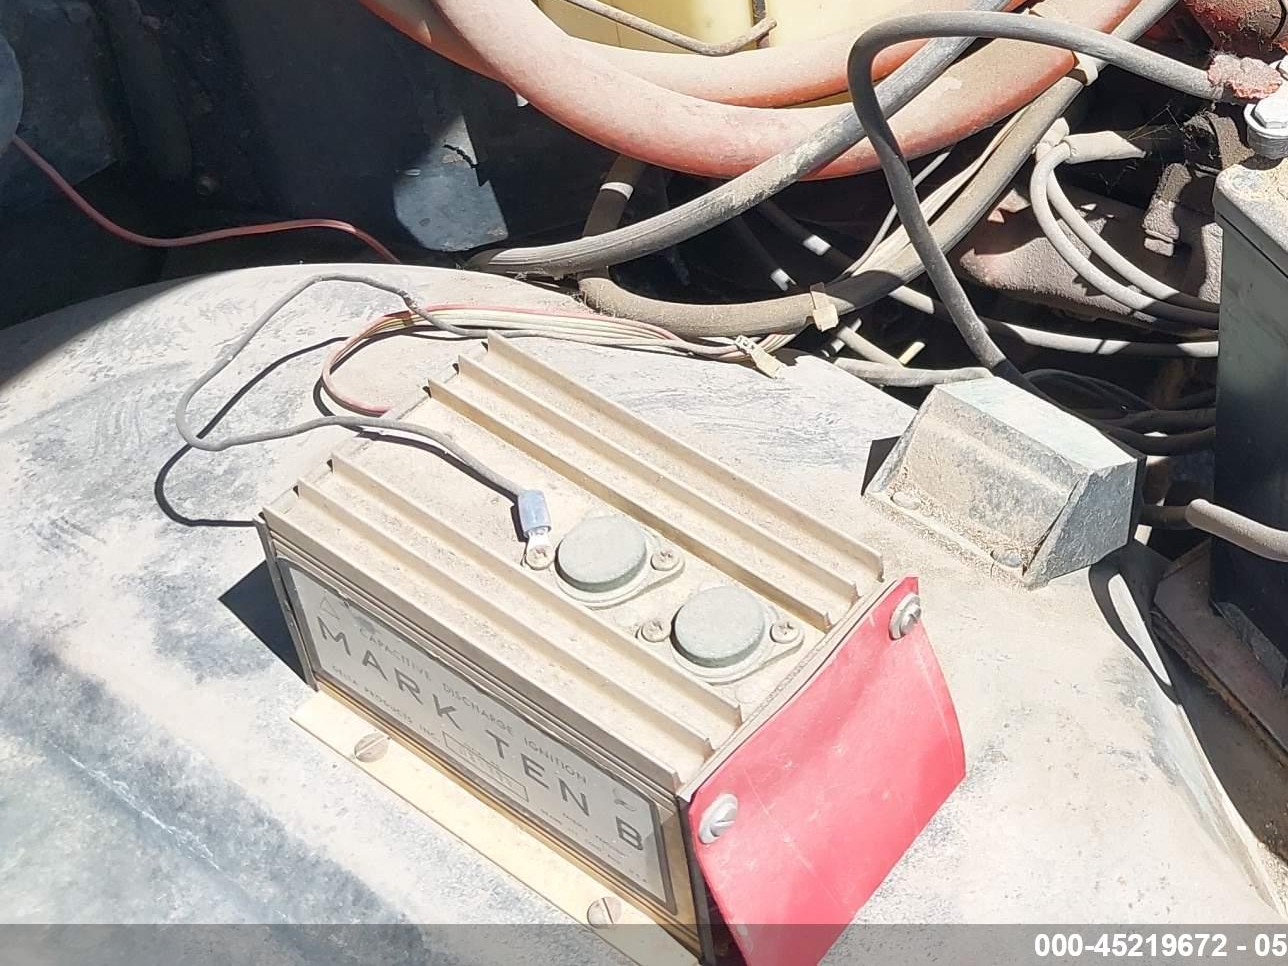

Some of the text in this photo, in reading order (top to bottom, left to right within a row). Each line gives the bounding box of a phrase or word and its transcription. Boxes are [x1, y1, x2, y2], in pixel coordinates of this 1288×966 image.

[319, 619, 463, 730] MARK
[485, 732, 591, 817] TEN
[616, 817, 645, 852] B
[358, 626, 432, 684] CAPACITIVE
[441, 681, 514, 736] DISCHARGE
[522, 735, 587, 785] IGNITION
